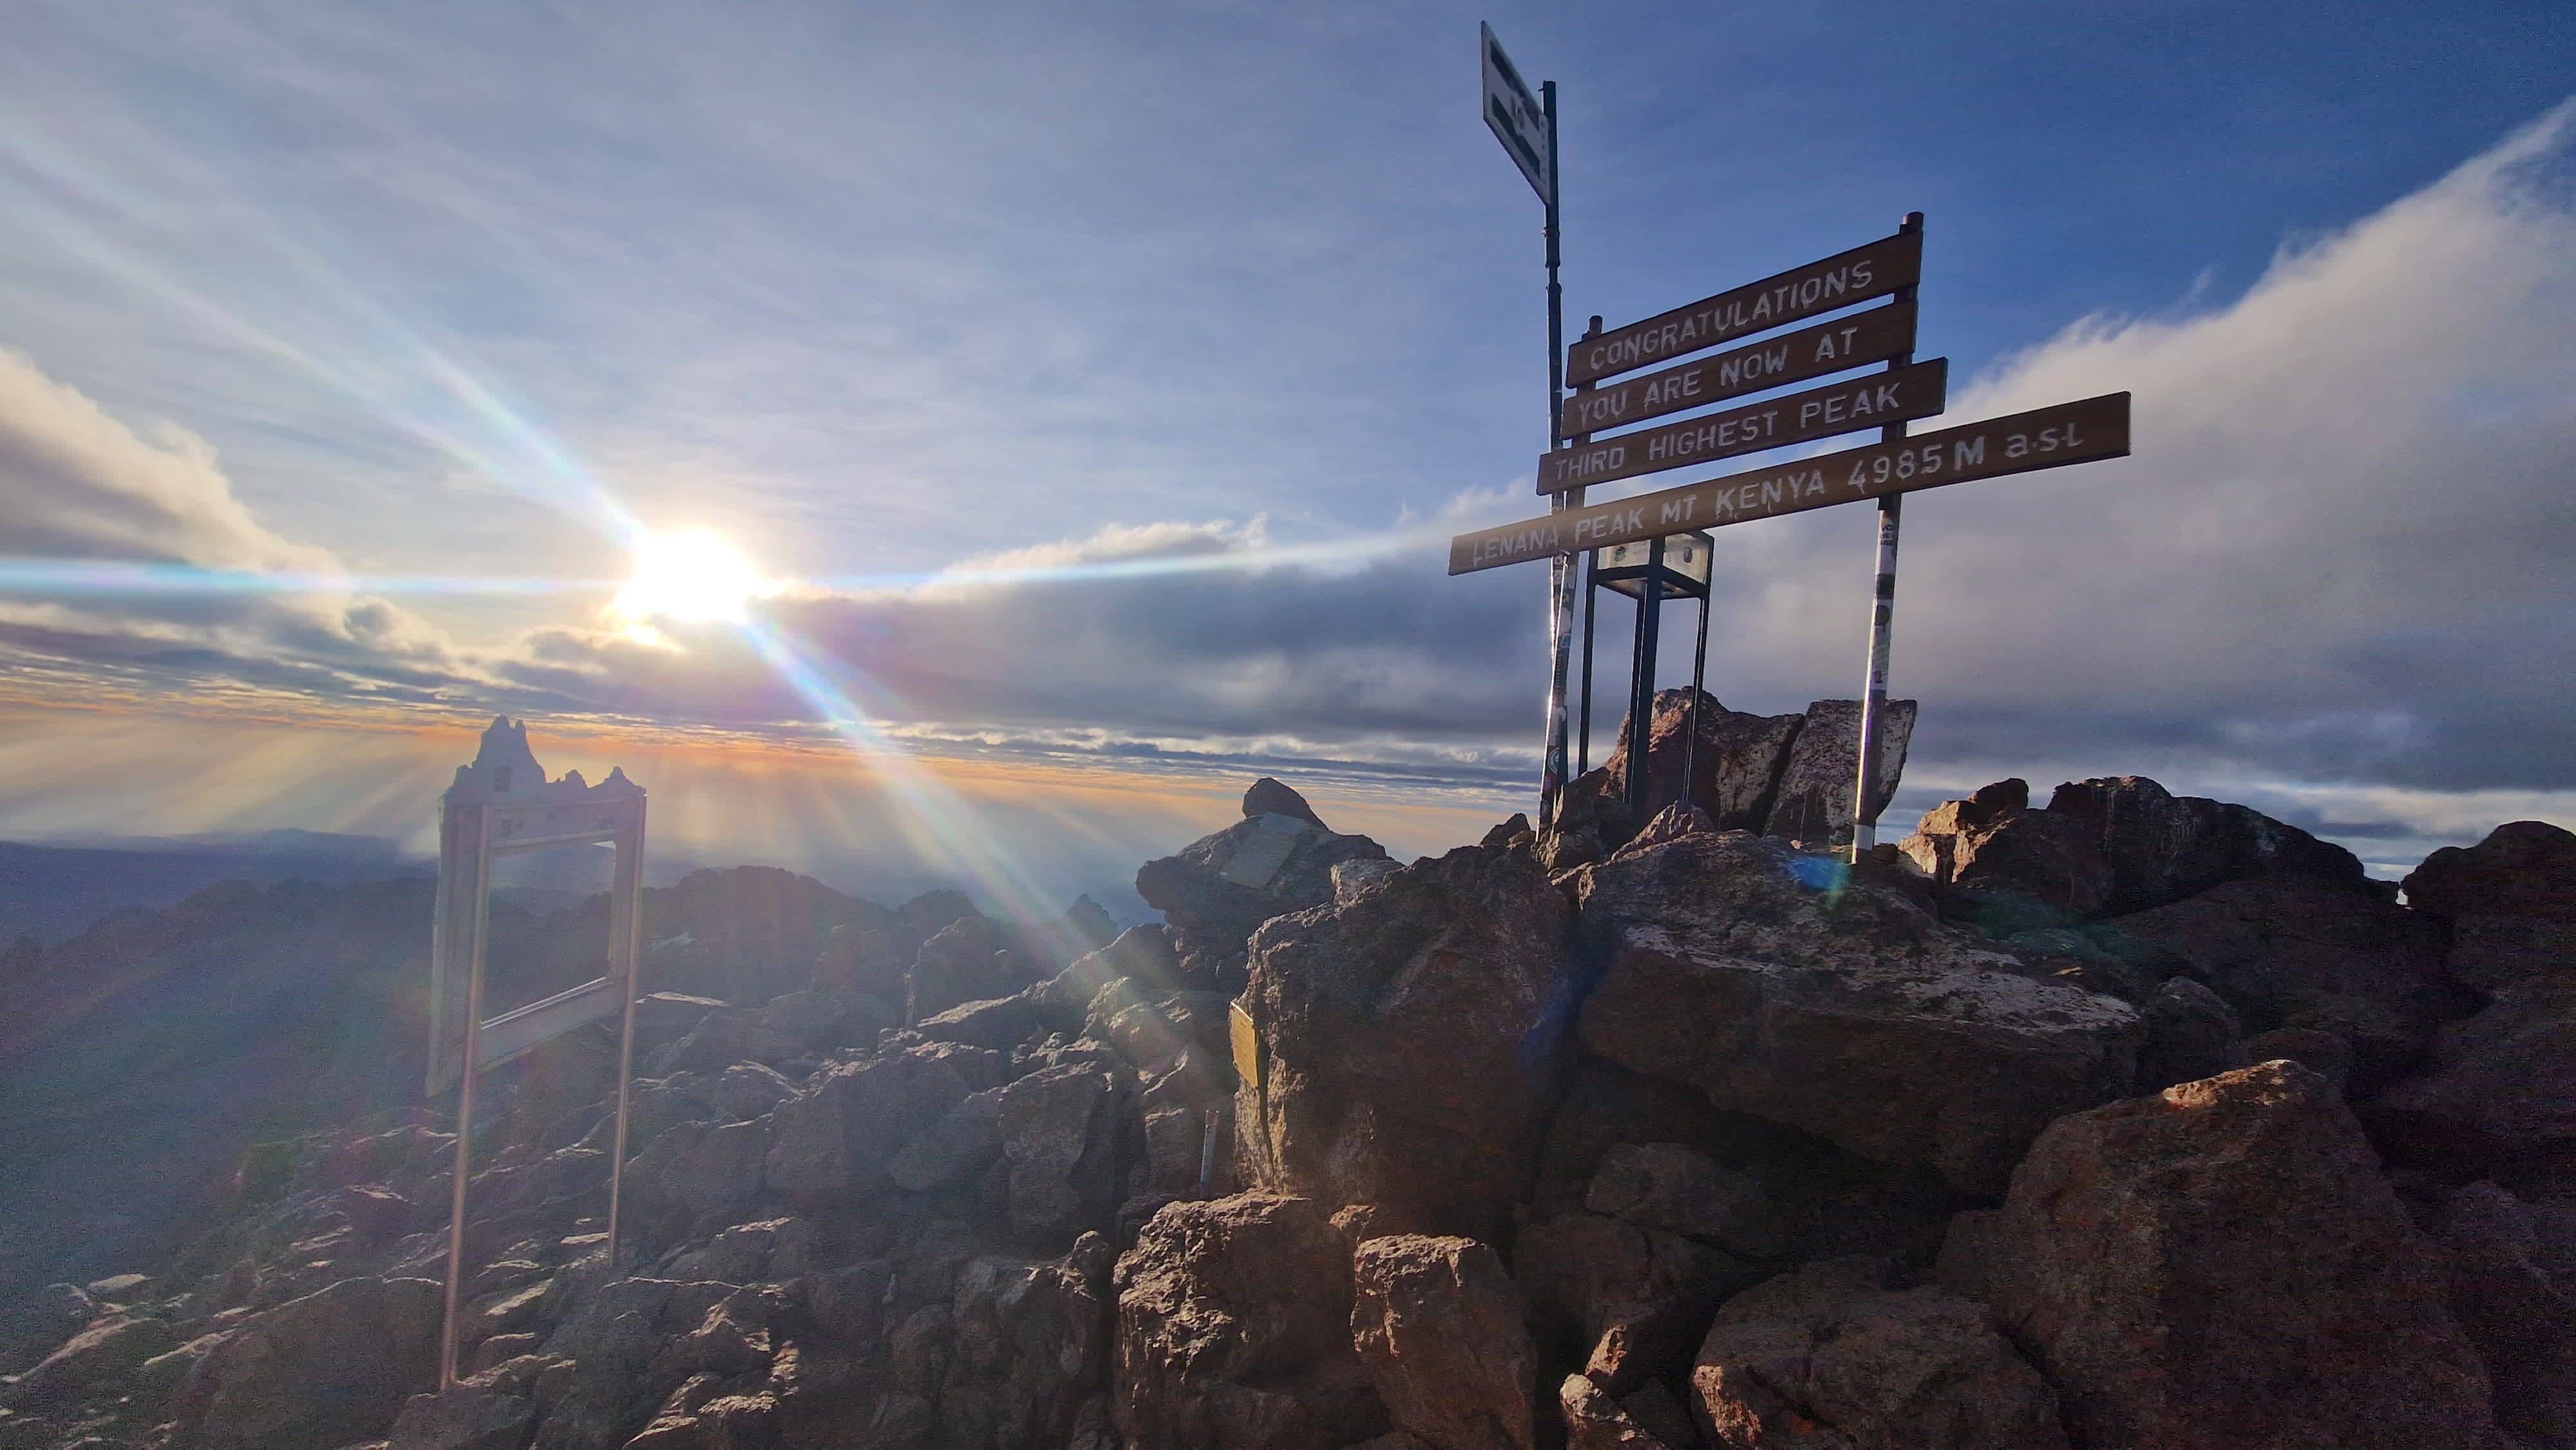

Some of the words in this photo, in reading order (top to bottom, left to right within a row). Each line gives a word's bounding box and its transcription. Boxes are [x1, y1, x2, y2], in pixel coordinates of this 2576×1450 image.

[1590, 259, 1872, 371] CONGRATULATIONS
[1578, 391, 1627, 428] YOU
[1644, 370, 1702, 412] ARE
[1720, 344, 1789, 387] NOW
[1815, 326, 1859, 363] AT
[1555, 446, 1625, 480] THIRD
[1649, 411, 1778, 462] HIGHEST
[1799, 382, 1901, 428] PEAK
[1472, 525, 1559, 568] LENANA
[1575, 507, 1645, 542] PEAK
[1660, 494, 1697, 524] MT
[1714, 469, 1825, 516] KENYA
